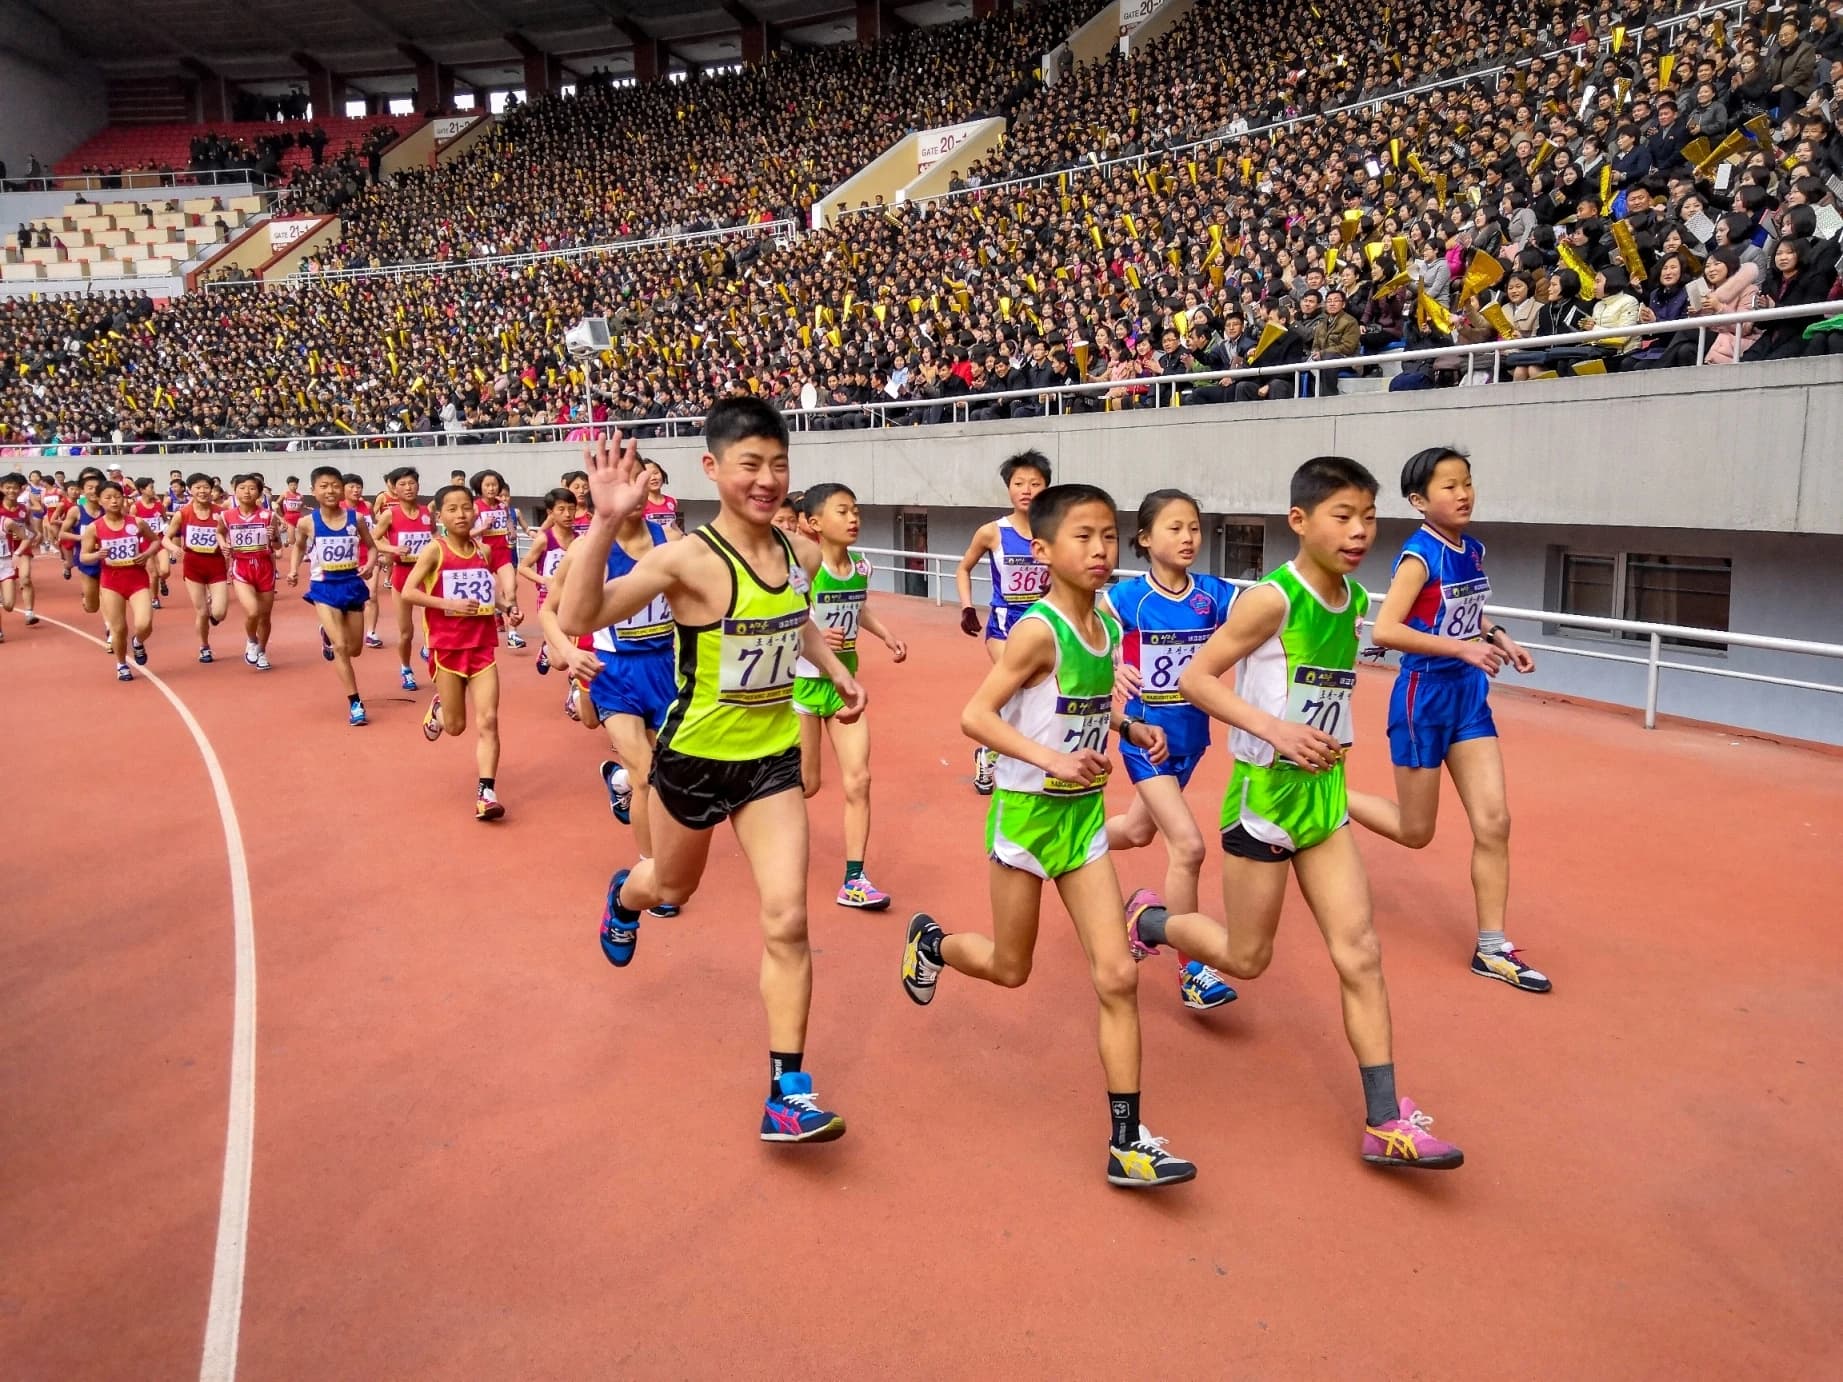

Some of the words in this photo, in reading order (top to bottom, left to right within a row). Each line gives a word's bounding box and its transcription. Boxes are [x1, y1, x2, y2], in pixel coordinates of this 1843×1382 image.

[1124, 10, 1139, 20] GATE
[1140, 0, 1163, 16] 20-
[922, 147, 939, 157] GATE
[274, 231, 288, 239] GATE
[190, 532, 217, 547] 859
[235, 532, 260, 546] 861
[108, 543, 136, 560] 883
[322, 543, 354, 562] 694
[453, 580, 492, 603] 533
[825, 610, 860, 636] 70
